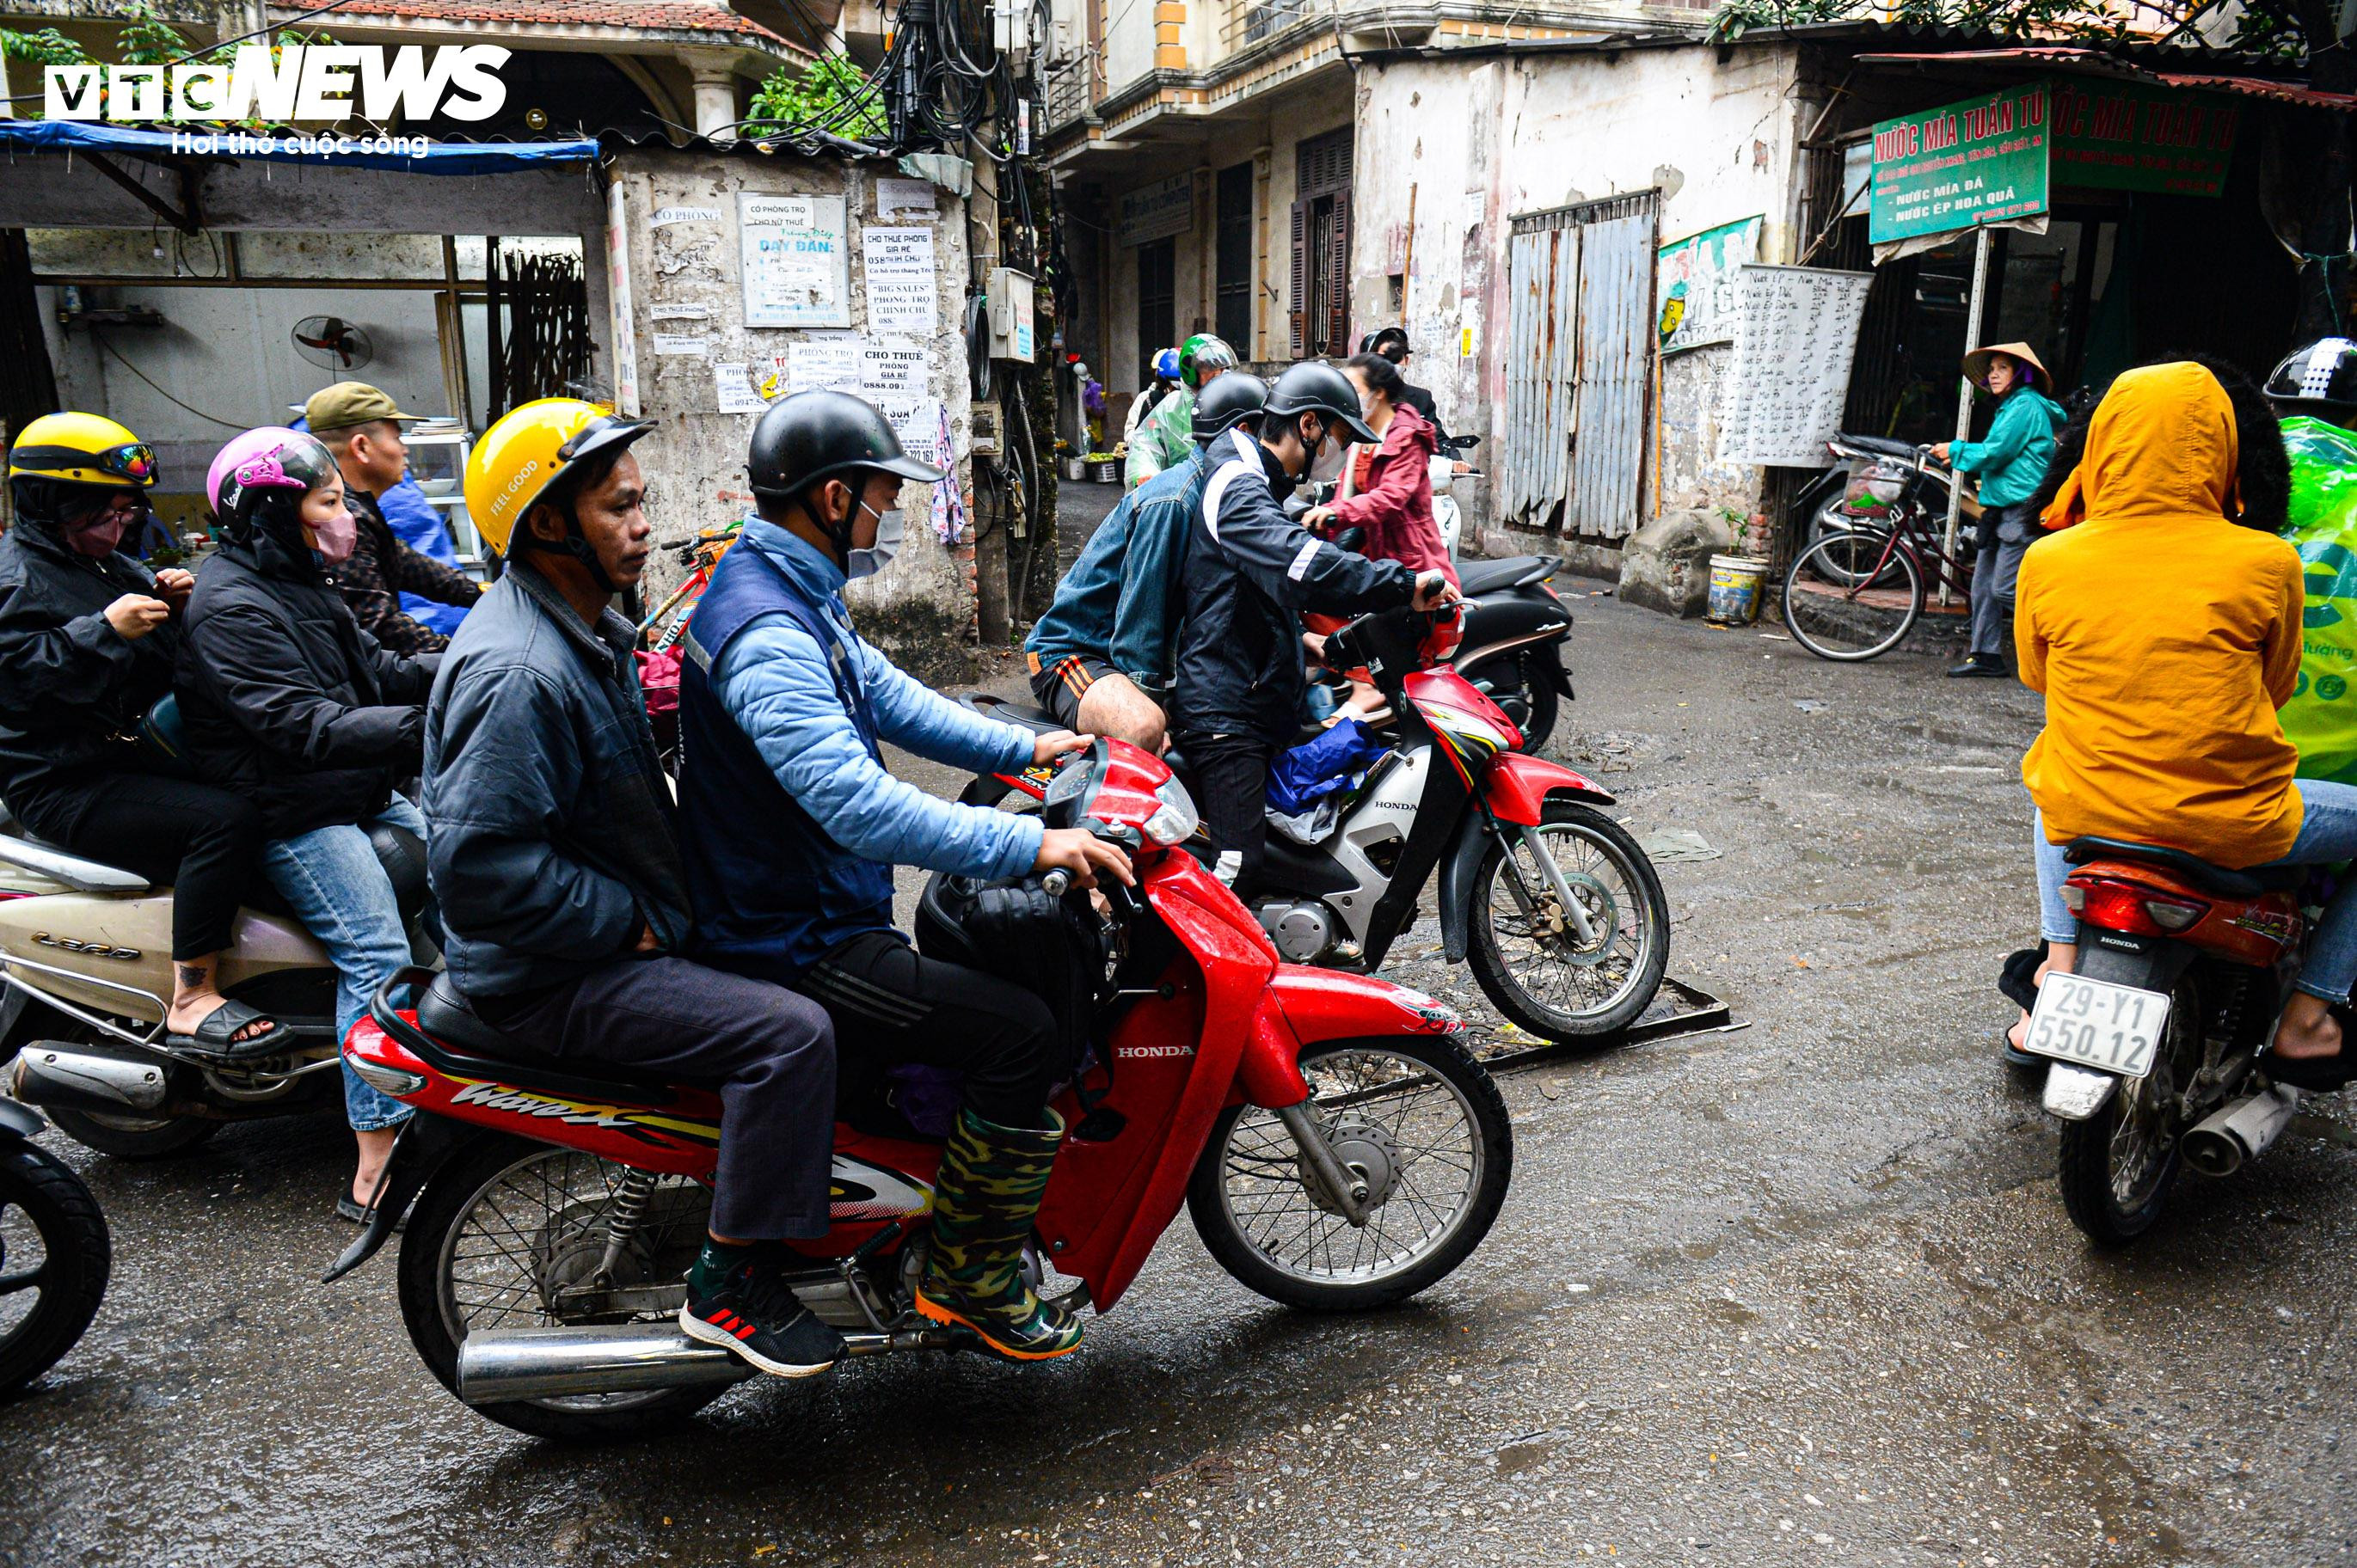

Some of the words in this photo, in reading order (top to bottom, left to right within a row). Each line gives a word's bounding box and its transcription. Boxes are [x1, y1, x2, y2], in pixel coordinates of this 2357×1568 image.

[1874, 121, 1918, 163] NƯỚC
[1924, 110, 1958, 153] MÍA
[1964, 92, 2013, 143] TUẤN
[2020, 89, 2044, 128] TÚ
[1896, 187, 1930, 206] NƯỚC
[1934, 181, 1960, 198] MÍA
[1964, 175, 1984, 191] ĐÁ
[1895, 205, 1930, 223] NƯỚC
[1933, 199, 1951, 215] ÉP
[1955, 197, 1982, 211] HOA
[865, 351, 888, 359] CHO
[893, 350, 924, 360] THUÊ
[490, 493, 511, 517] FEEL
[507, 460, 537, 493] GOOD
[1375, 800, 1419, 811] HONDA
[2100, 936, 2140, 950] HONDA
[2055, 982, 2146, 1030] 29-Y1
[1118, 1045, 1195, 1058] HONDA
[2035, 1014, 2147, 1070] 550.12
